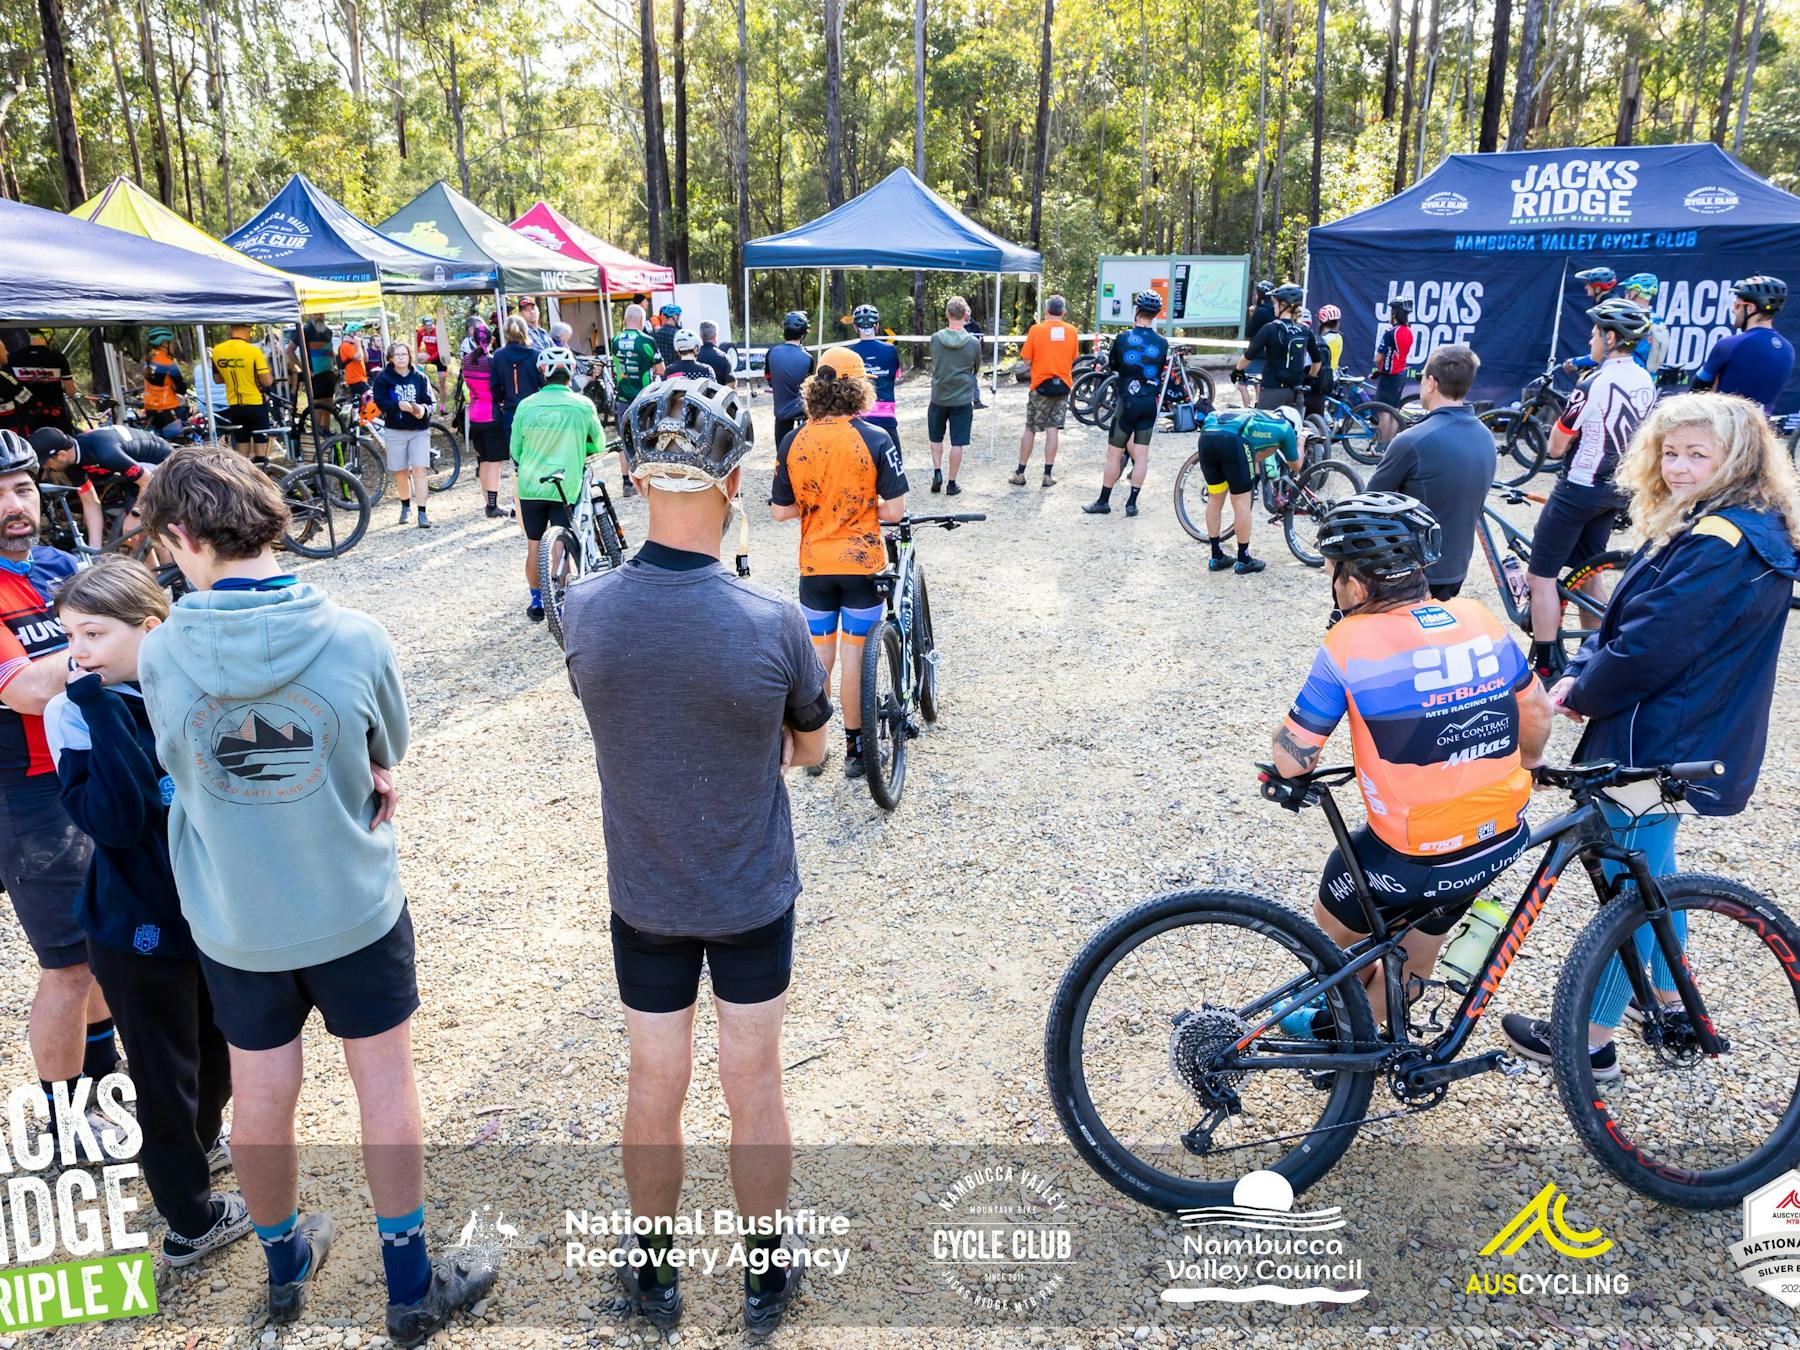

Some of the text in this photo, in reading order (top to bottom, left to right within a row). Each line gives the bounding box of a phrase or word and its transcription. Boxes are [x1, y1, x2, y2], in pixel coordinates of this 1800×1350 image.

[1511, 160, 1640, 193] JACKS
[1511, 188, 1633, 219] RIDGE
[286, 216, 310, 234] VALLEY
[1509, 215, 1631, 225] MOUNTAIN BIKE PARK
[268, 237, 308, 248] CLUB
[1455, 231, 1699, 251] NAMBUCCA VALLEY CYCLE CLUB
[1425, 690, 1510, 719] MTB RACING TEAM
[1436, 716, 1511, 746] ONE CONTRACT
[1441, 735, 1511, 770] Mitas
[1438, 870, 1487, 892] Down
[1466, 866, 1558, 1020] S-WORKS
